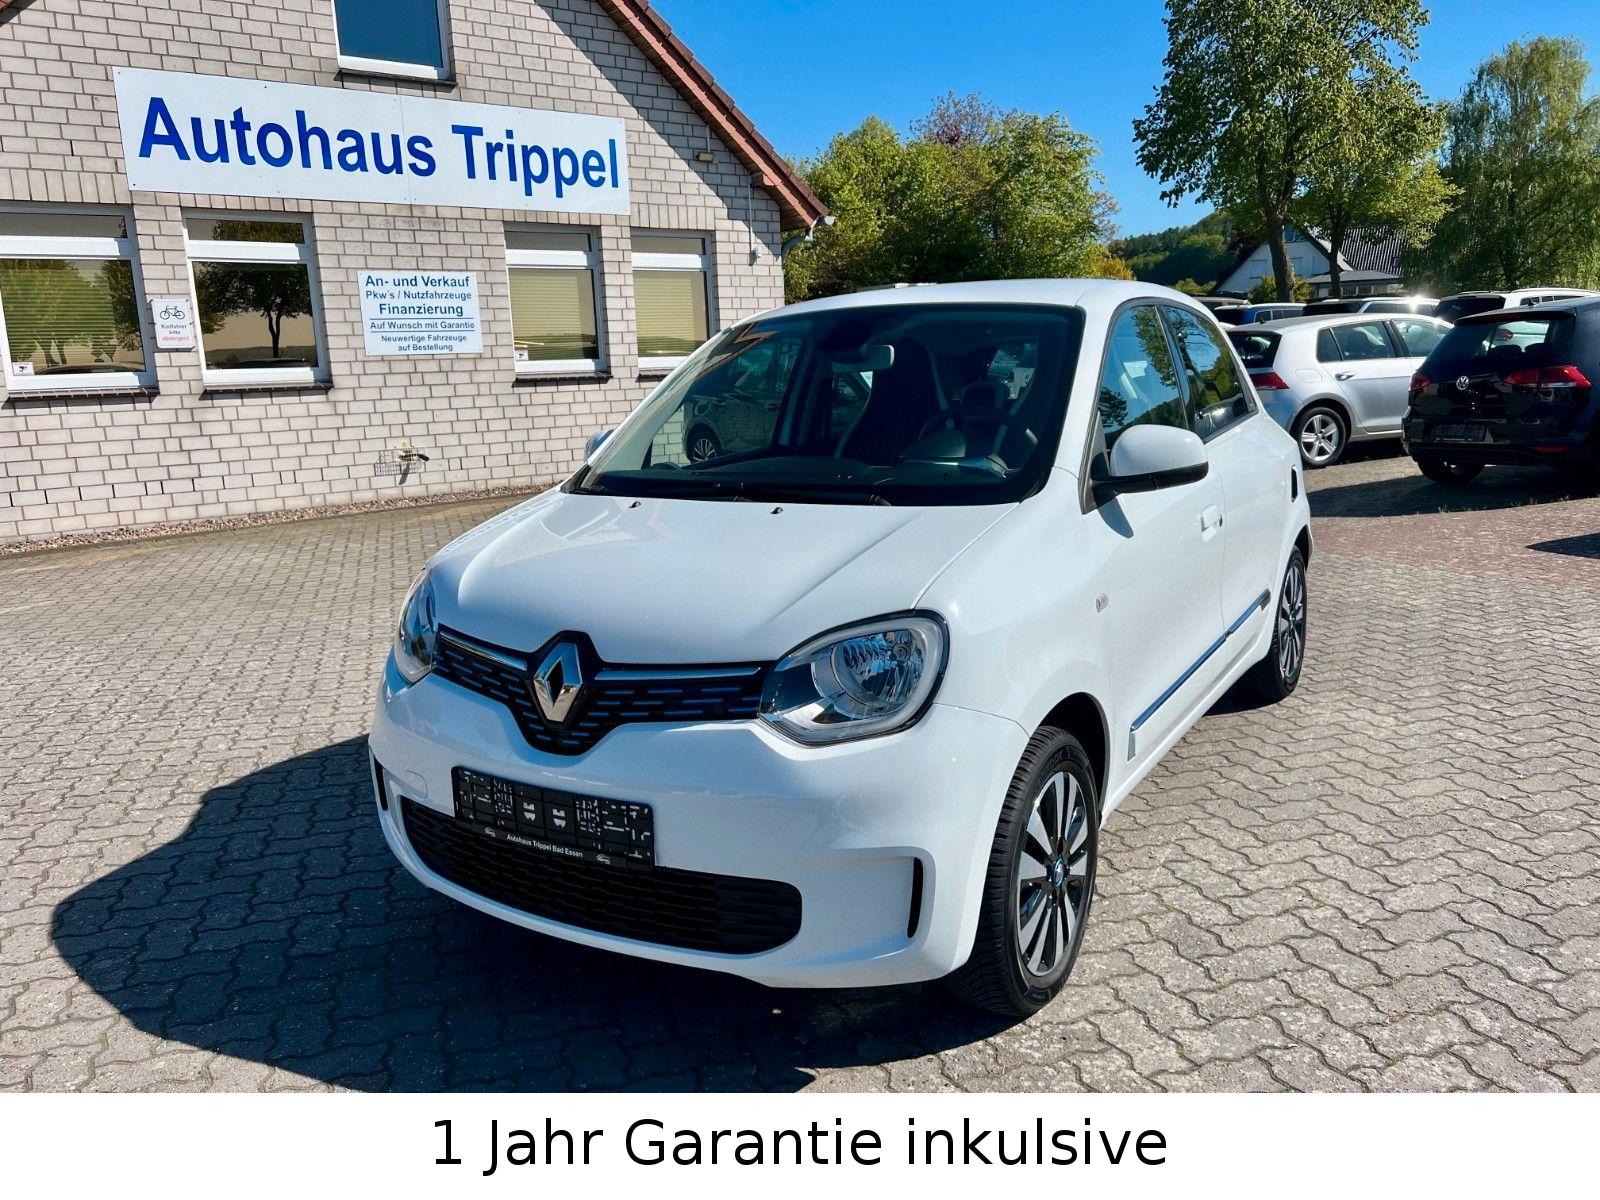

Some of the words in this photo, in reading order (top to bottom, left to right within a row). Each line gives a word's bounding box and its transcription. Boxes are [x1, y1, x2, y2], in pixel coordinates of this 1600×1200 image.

[137, 96, 437, 177] Autohaus
[451, 124, 619, 198] Trippel
[365, 275, 389, 287] An-
[393, 275, 417, 287] und
[421, 275, 470, 287] Verkauf
[403, 291, 472, 301] Nutzfahrzeuge
[379, 303, 464, 316] Finanzierung
[370, 321, 385, 329] Auf
[388, 321, 423, 329] Wunsch
[425, 321, 438, 329] mit
[440, 321, 475, 329] Garantie
[381, 335, 425, 343] Neuwertige
[427, 335, 467, 343] Fahrzeuge
[506, 833, 532, 846] Autohaus
[533, 840, 552, 851] Trippel
[552, 845, 564, 854] Bad
[565, 848, 583, 858] Essen
